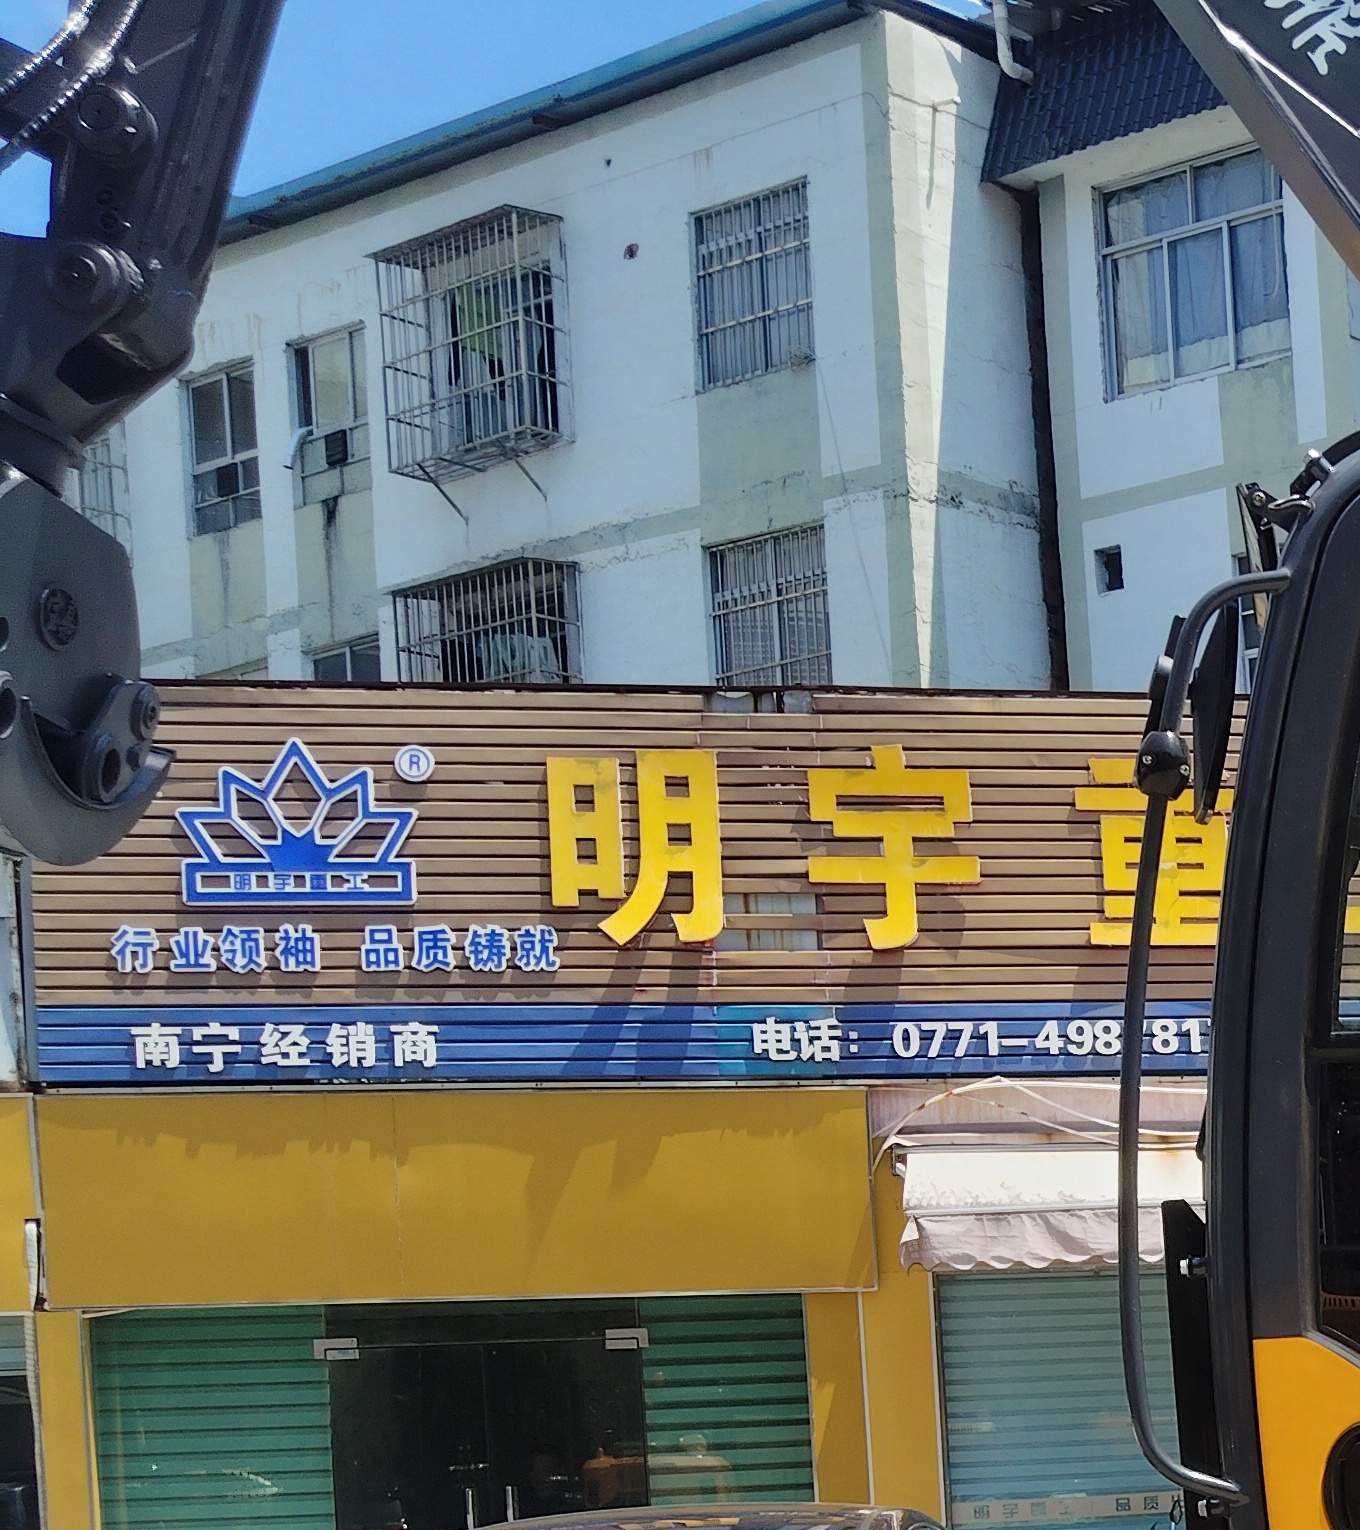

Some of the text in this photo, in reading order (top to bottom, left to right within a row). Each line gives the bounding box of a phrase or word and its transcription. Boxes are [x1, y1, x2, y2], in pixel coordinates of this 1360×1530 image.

[111, 923, 560, 974] 行业领袖 品质铸就
[131, 1022, 440, 1073] 南宁经销商
[892, 1018, 1211, 1058] 0771-49881
